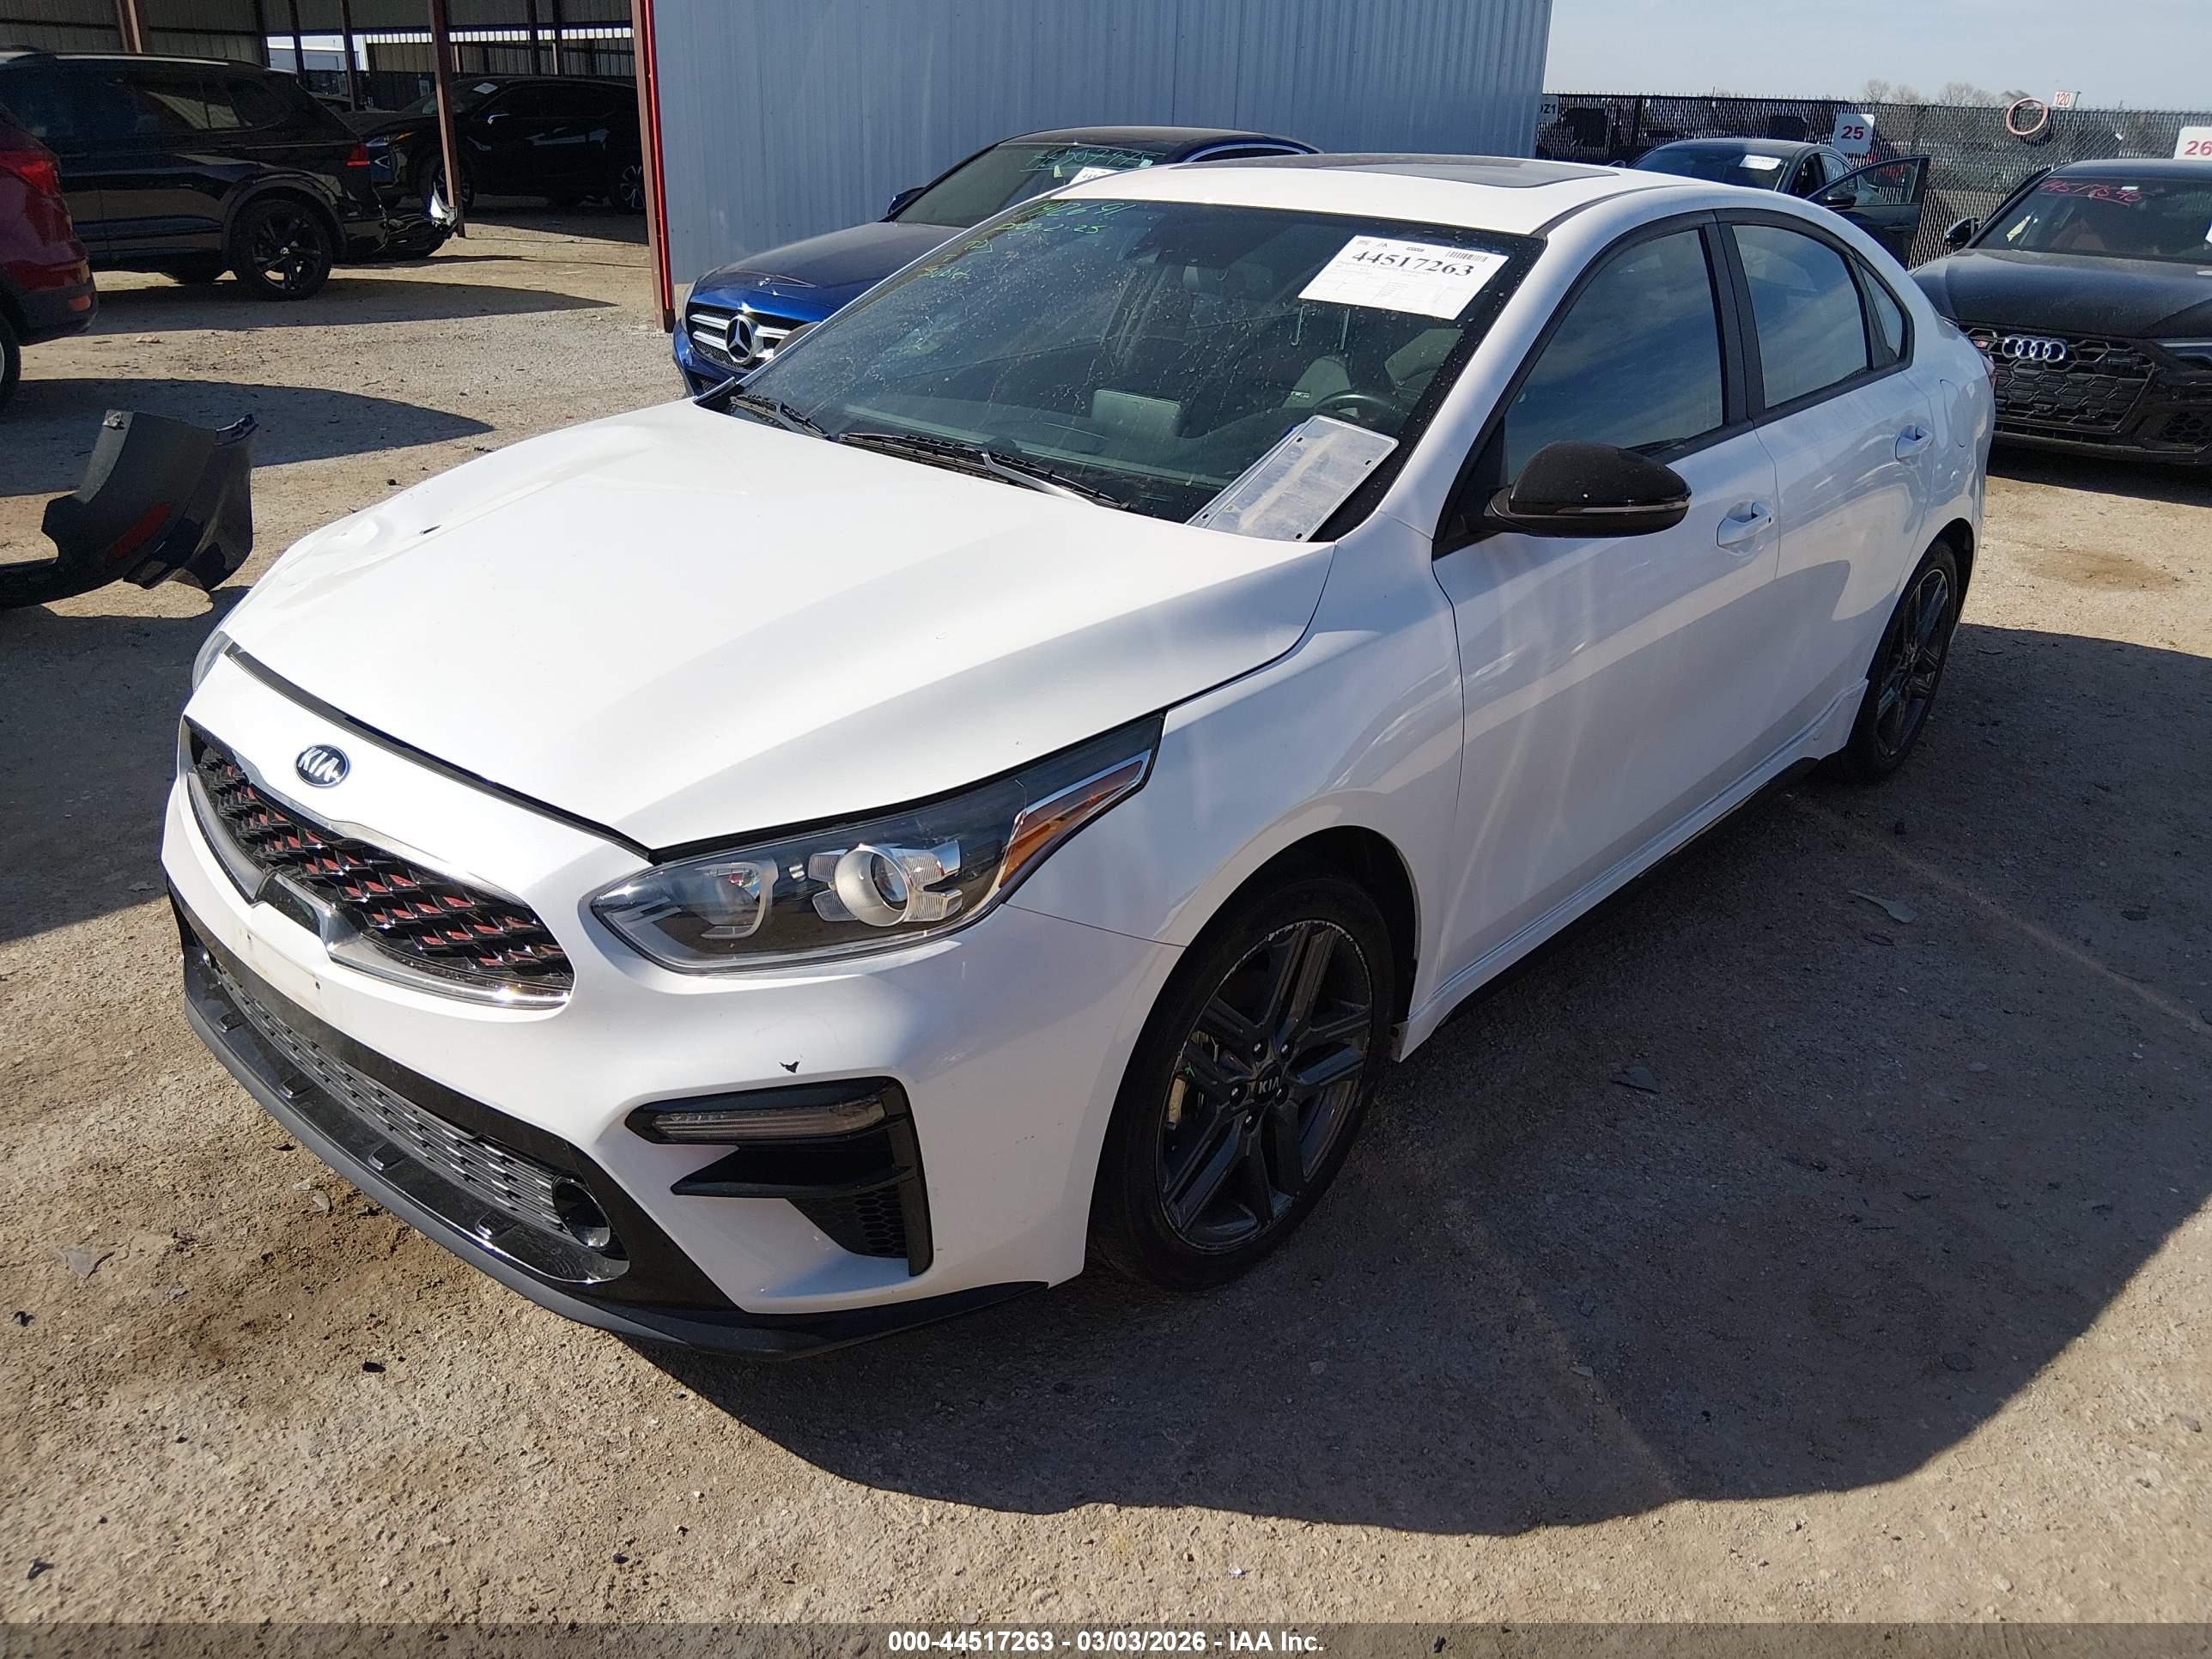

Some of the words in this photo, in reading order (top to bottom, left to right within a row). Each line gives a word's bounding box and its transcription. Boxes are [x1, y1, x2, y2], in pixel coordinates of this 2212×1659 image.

[2056, 92, 2070, 106] 120
[1840, 125, 1865, 140] 25
[2184, 139, 2212, 156] 26
[1352, 250, 1474, 276] 44517263
[297, 746, 341, 783] KIA
[1258, 1076, 1279, 1094] KIA
